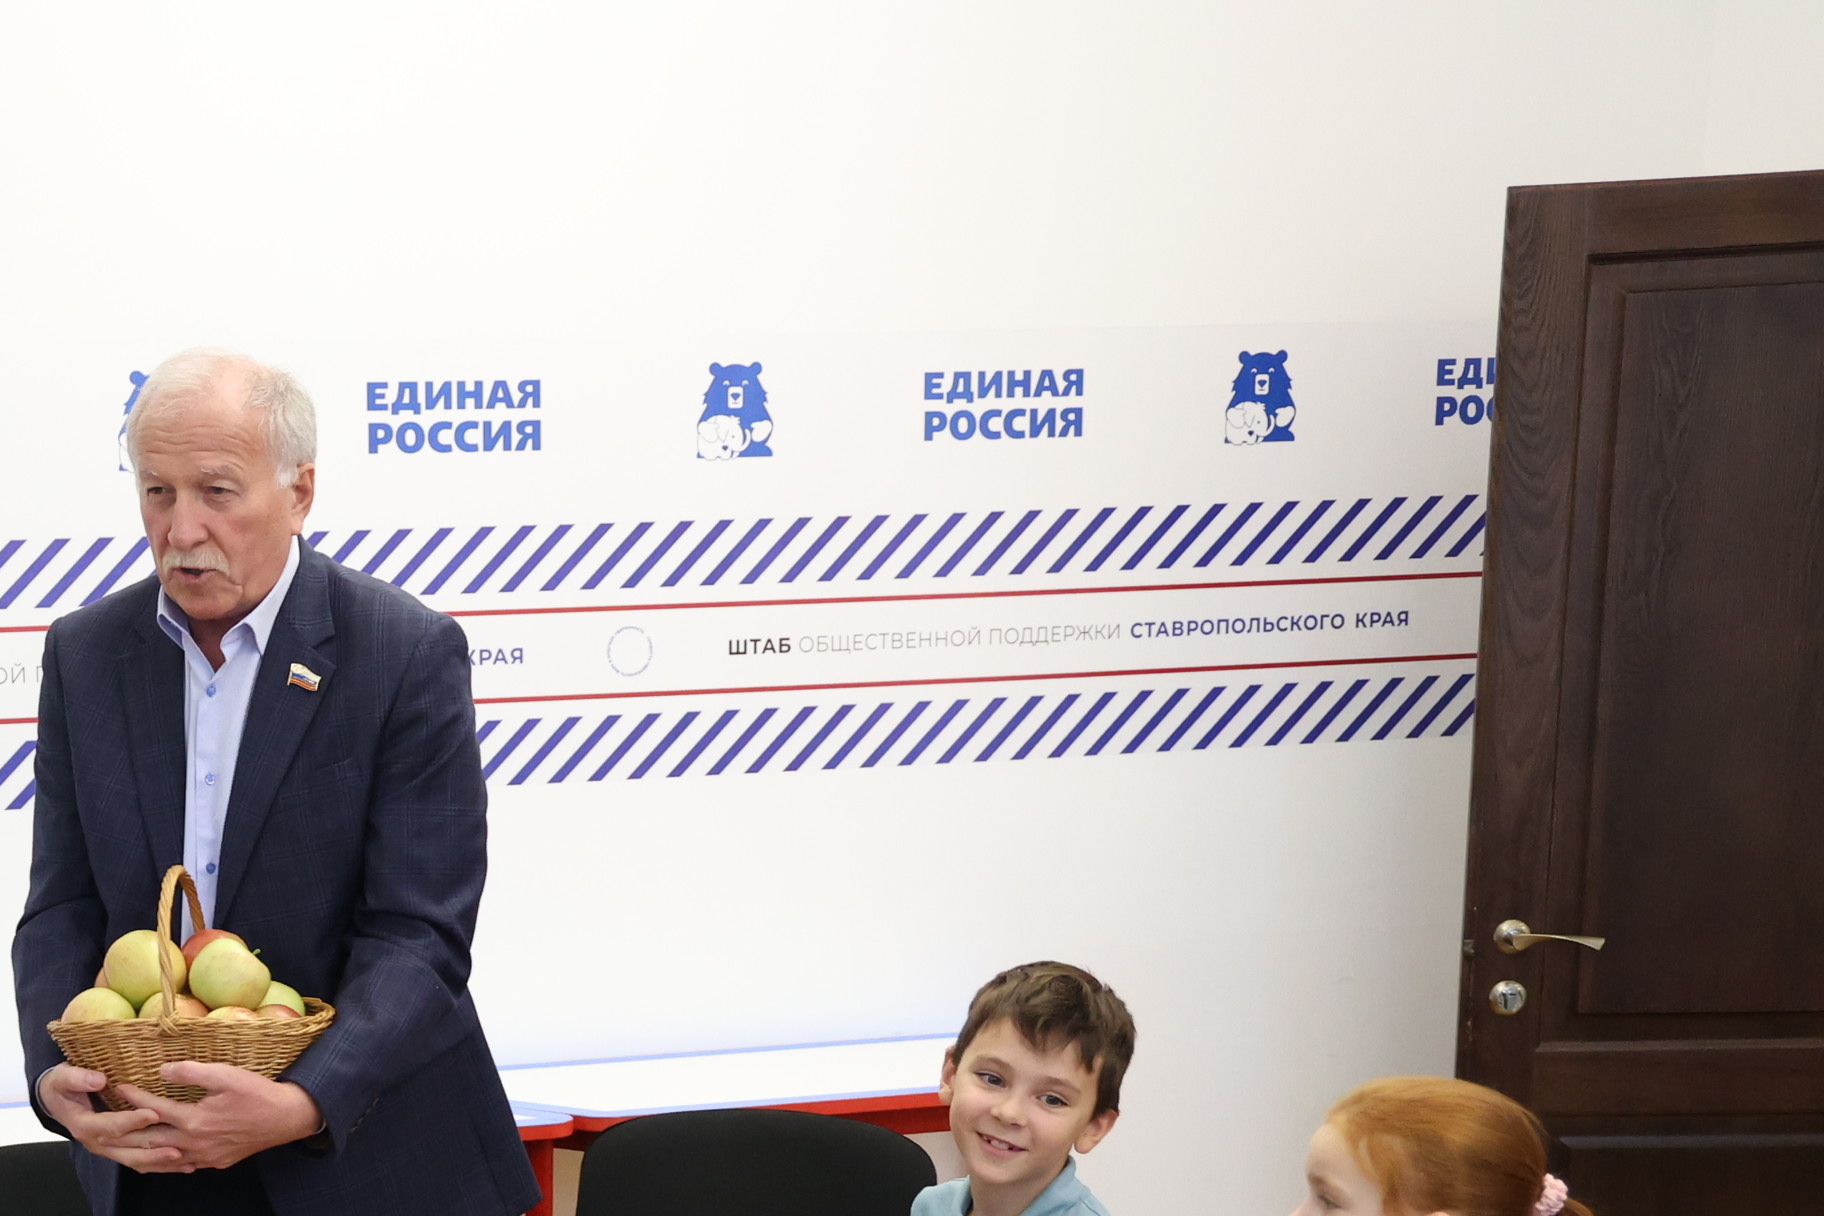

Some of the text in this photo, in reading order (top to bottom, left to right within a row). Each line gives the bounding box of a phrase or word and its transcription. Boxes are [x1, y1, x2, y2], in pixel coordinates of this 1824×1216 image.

[367, 380, 540, 415] ЕДИНАЯ
[924, 369, 1084, 404] ЕДИНАЯ
[368, 420, 541, 454] РОССИЯ
[925, 407, 1083, 441] РОССИЯ
[729, 611, 1408, 655] ШТАБ ОБЩЕСТВЕННОЙ ПОДДЕРЖКИ СТАВРОПОЛЬСКОГО КРАЯ
